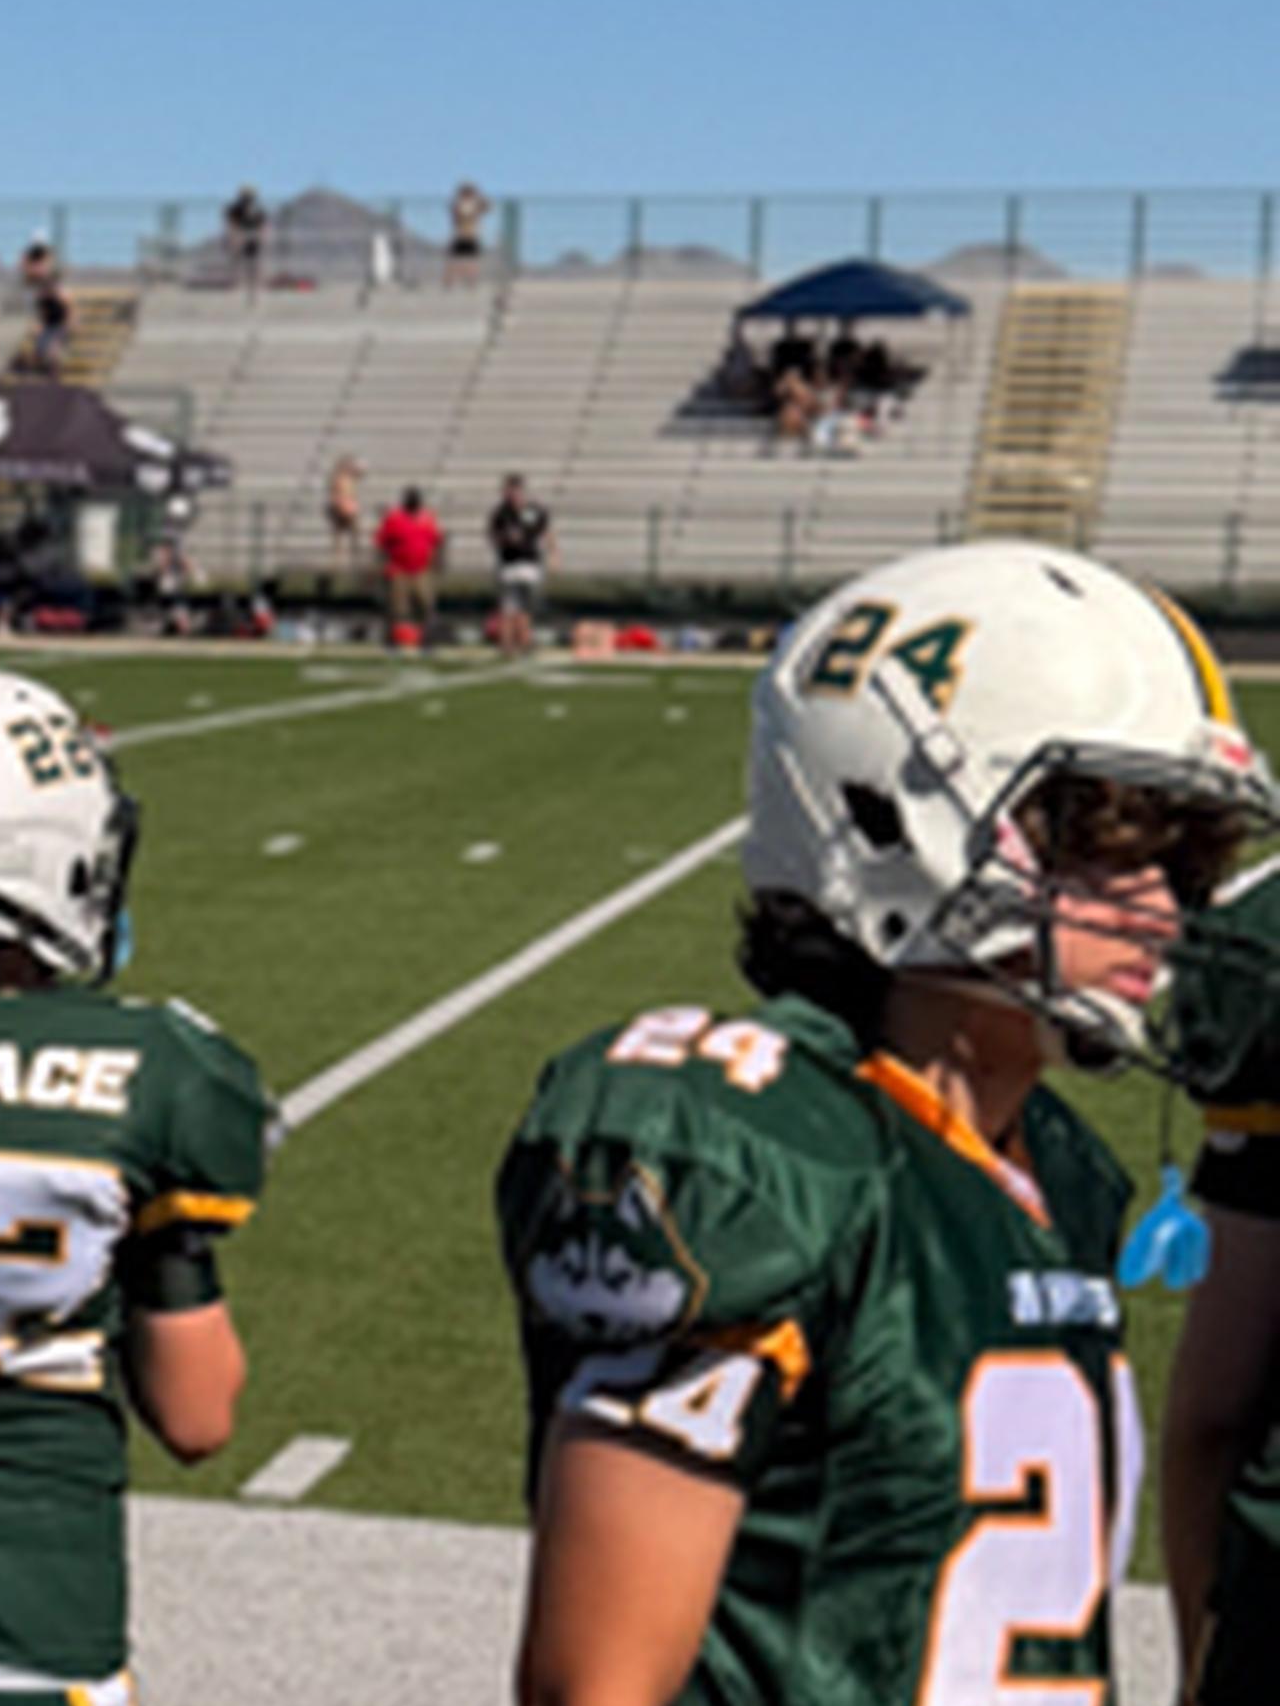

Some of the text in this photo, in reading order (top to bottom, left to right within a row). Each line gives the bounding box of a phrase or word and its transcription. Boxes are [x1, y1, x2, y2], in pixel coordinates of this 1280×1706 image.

[805, 596, 977, 717] 24
[3, 712, 97, 791] 22
[606, 1005, 789, 1095] 24
